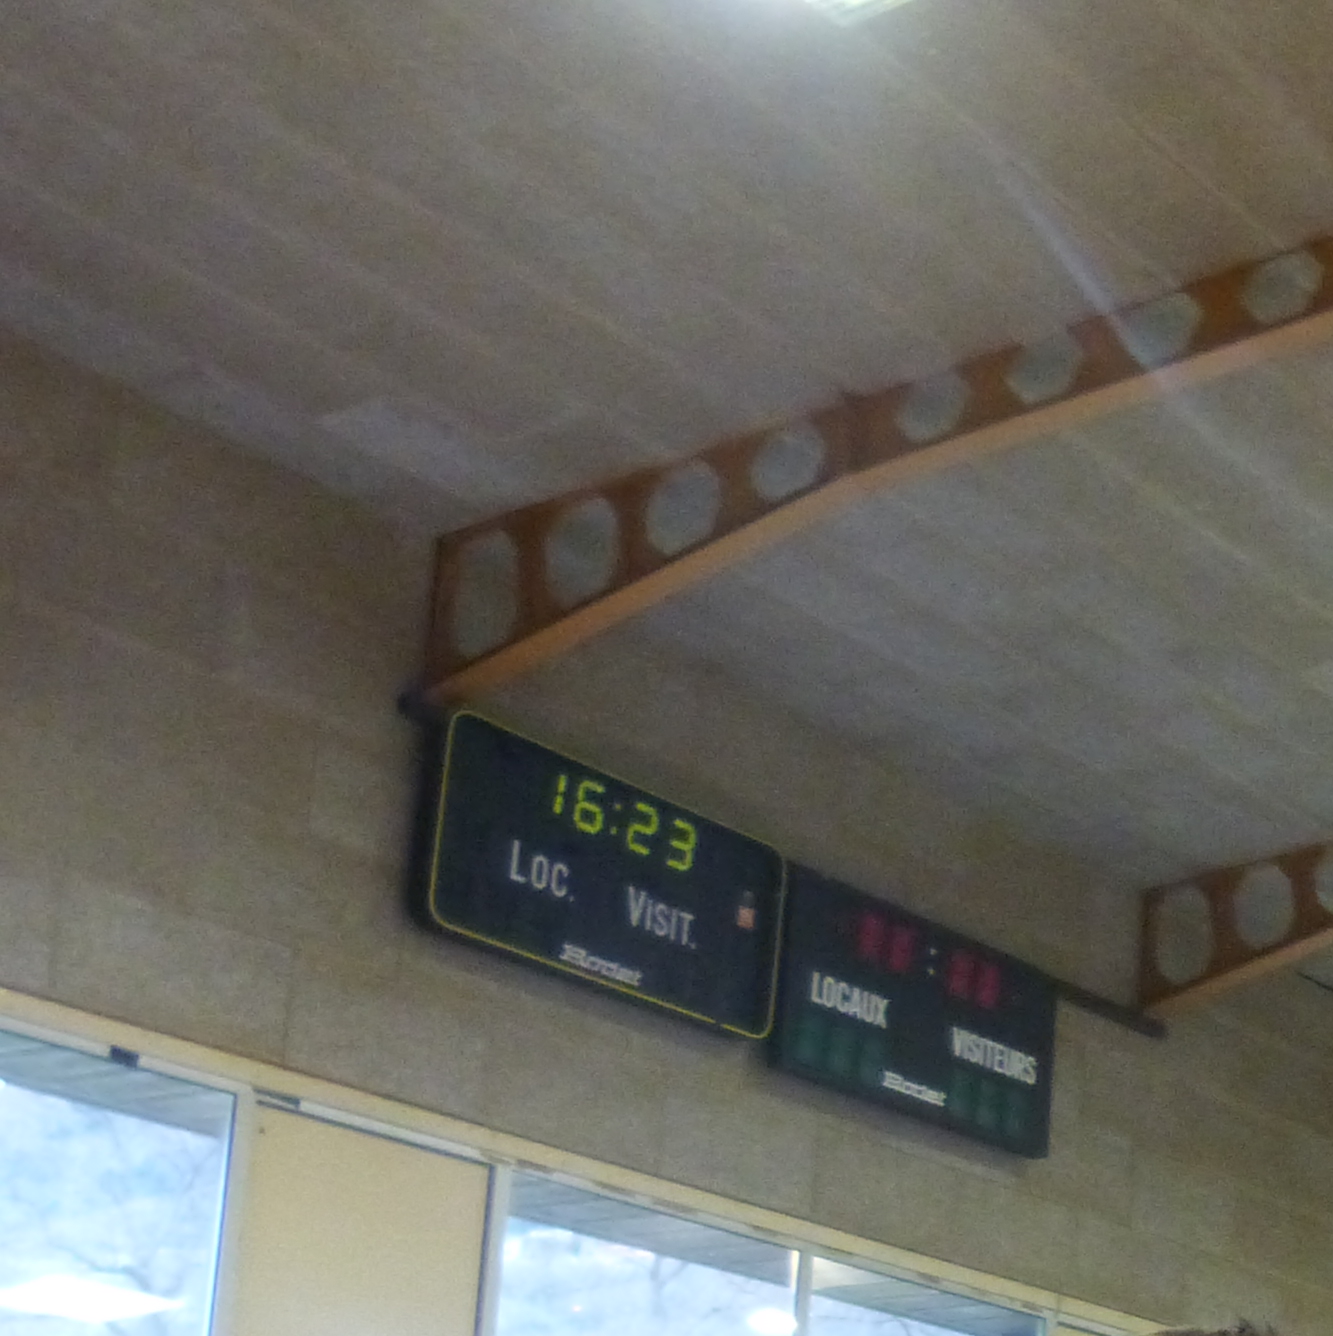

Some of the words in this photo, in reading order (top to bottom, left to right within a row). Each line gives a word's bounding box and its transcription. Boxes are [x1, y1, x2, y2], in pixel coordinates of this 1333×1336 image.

[551, 774, 696, 870] 16:23
[810, 971, 890, 1029] LOCAUX
[951, 1026, 1037, 1085] VISITEURS
